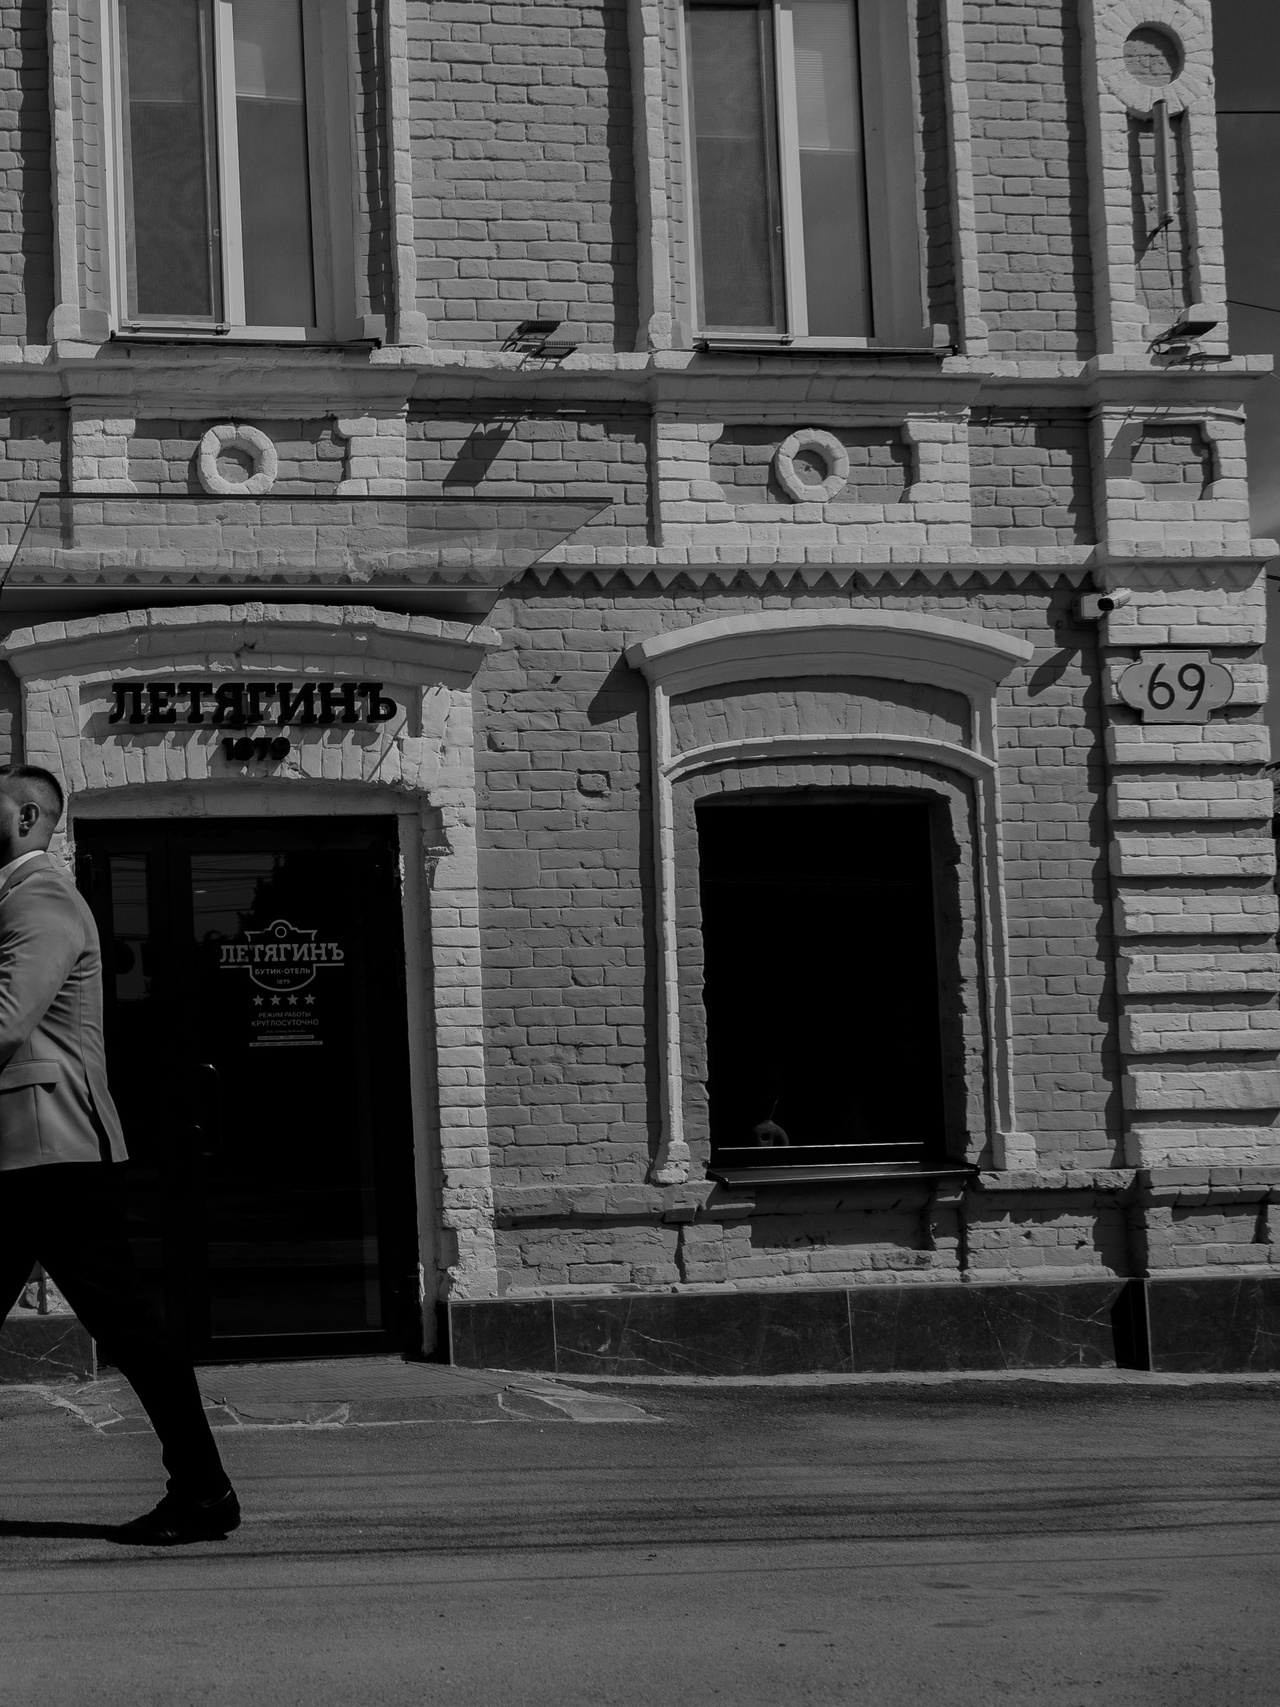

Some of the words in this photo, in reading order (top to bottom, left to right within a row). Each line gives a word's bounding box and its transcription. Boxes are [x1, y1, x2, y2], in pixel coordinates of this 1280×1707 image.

[1148, 663, 1205, 710] 69
[108, 682, 397, 724] ЛЕТЯГИНЪ
[222, 737, 291, 761] 1879
[219, 943, 345, 963] ЛЕТЯГИНЪ
[251, 1018, 319, 1027] КРУГЛОСУТОЧНО
